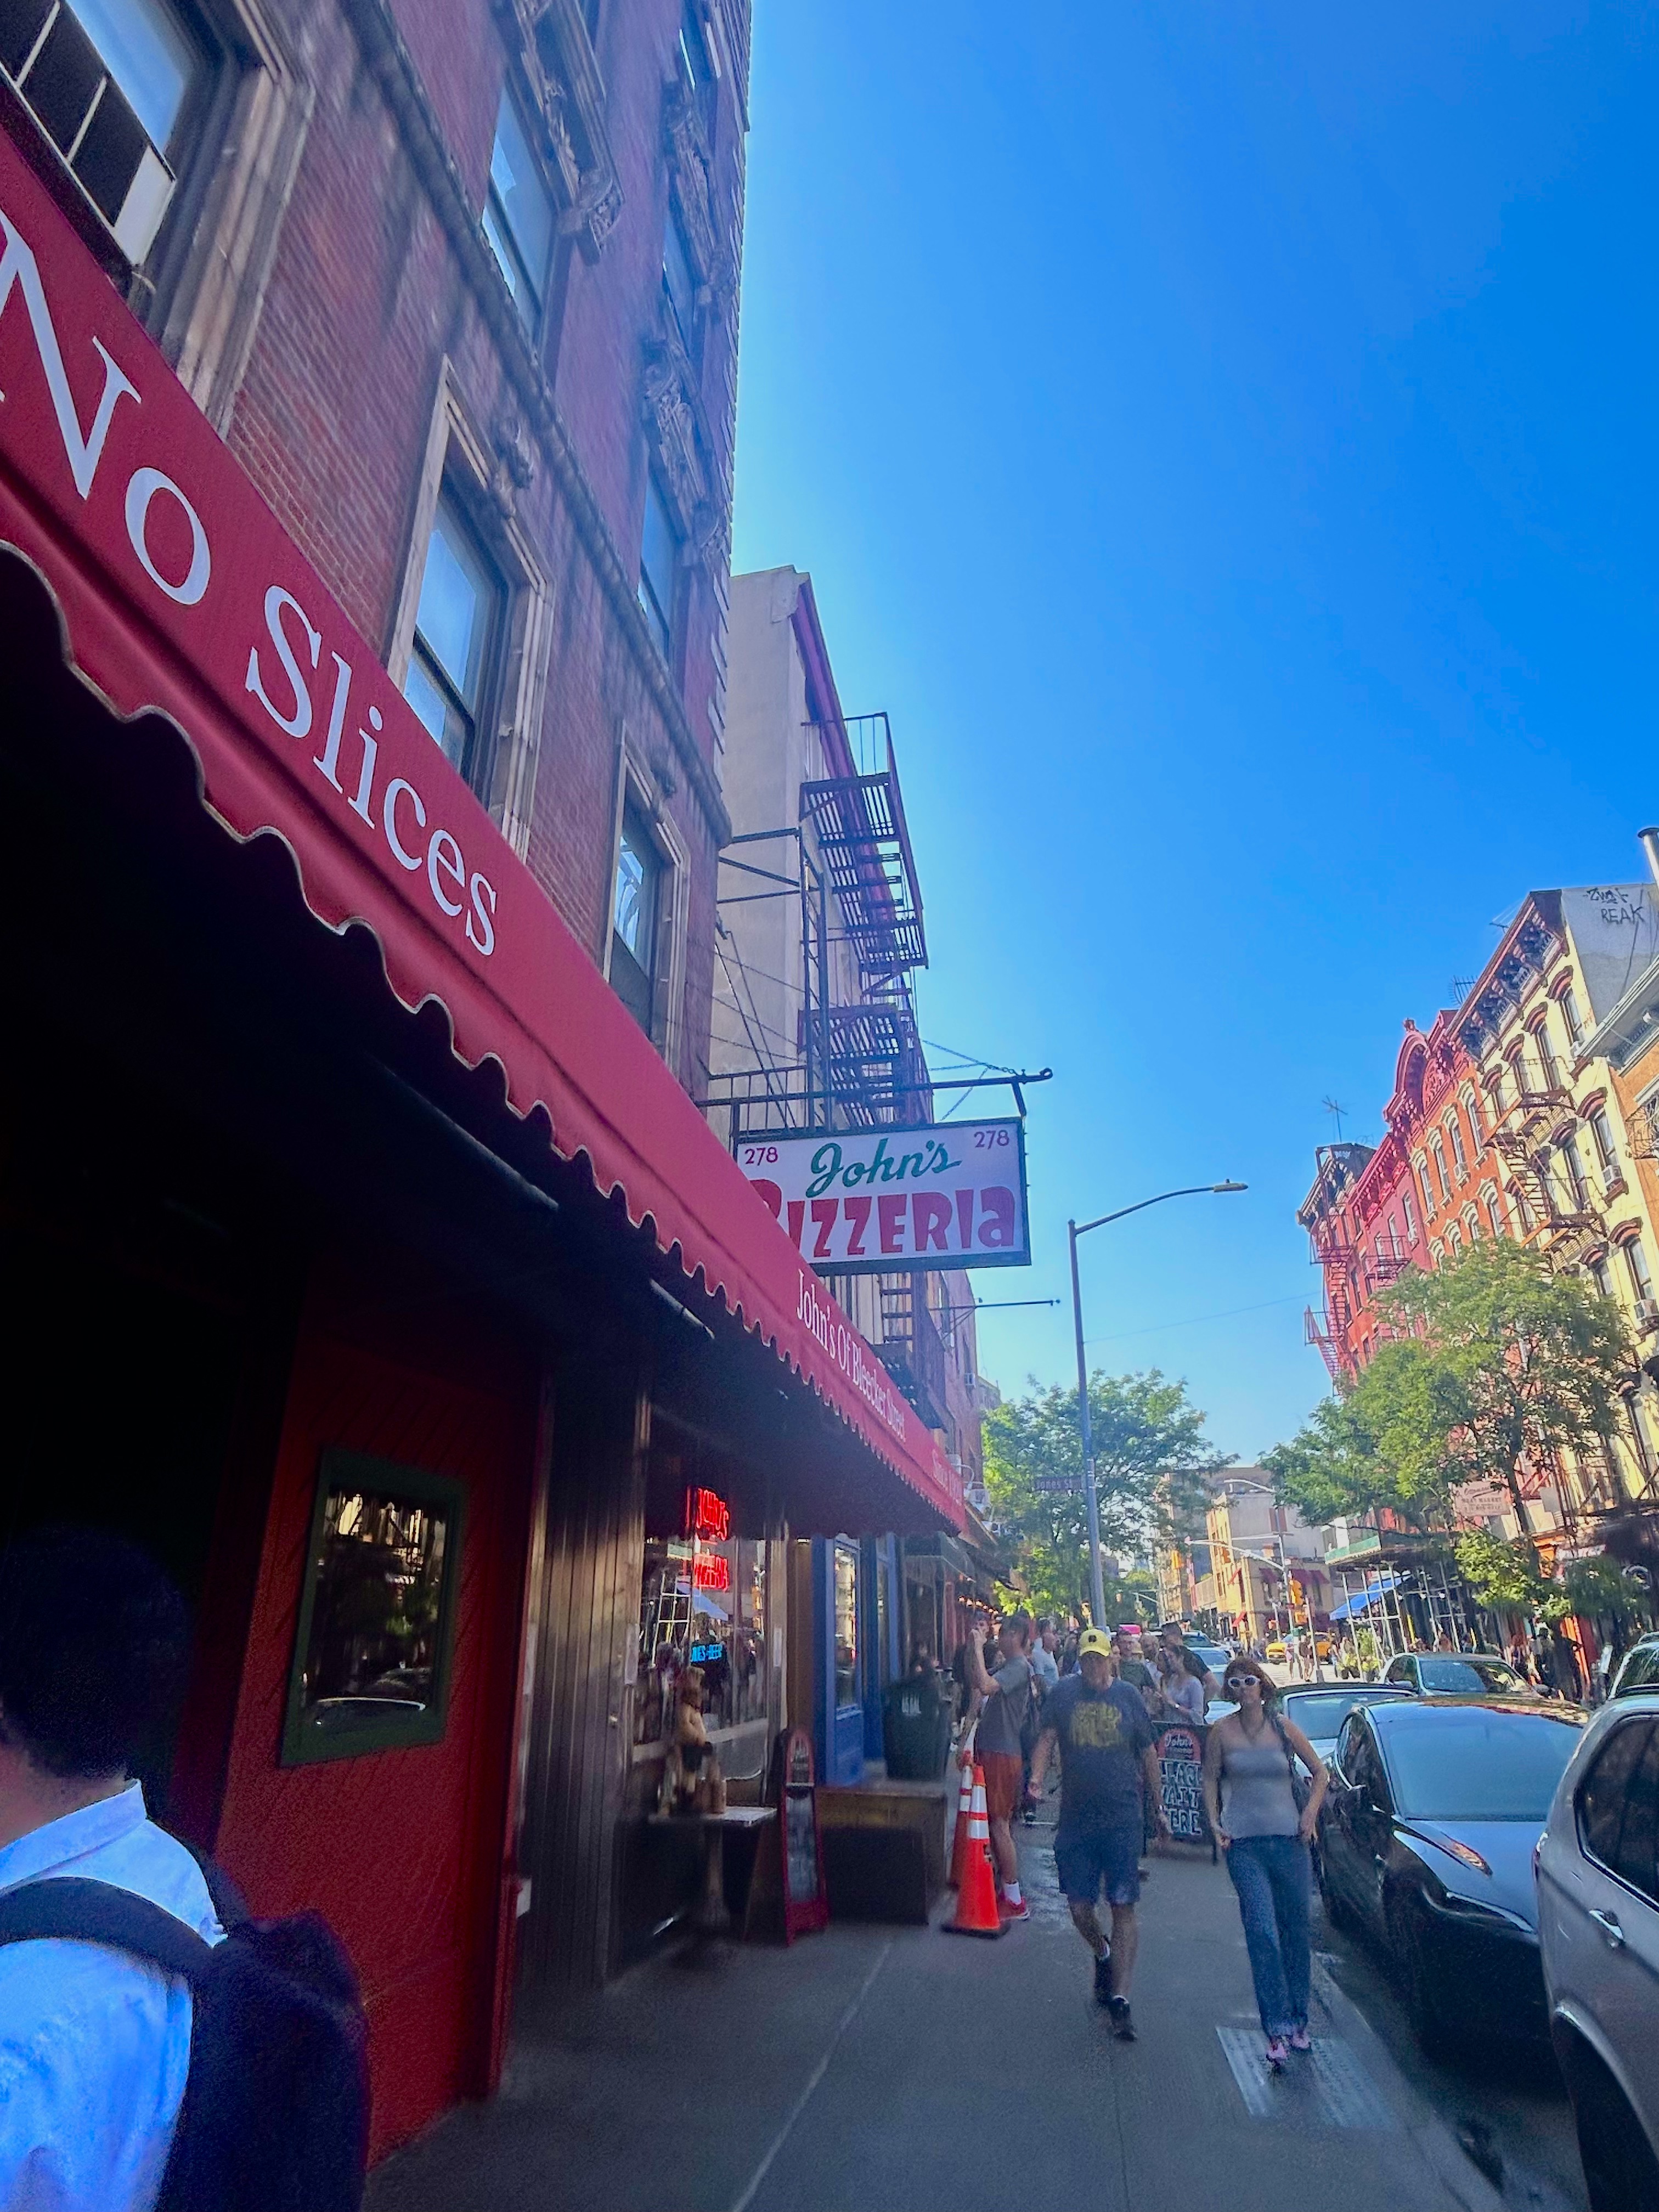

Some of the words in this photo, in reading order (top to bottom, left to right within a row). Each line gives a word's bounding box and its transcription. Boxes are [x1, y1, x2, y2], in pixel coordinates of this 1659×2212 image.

[0, 212, 212, 606] No
[244, 585, 498, 956] Slices
[744, 1146, 778, 1165] 278
[973, 1130, 1009, 1149] 278
[805, 1138, 962, 1198] John's
[797, 1268, 836, 1359] John's
[1169, 1808, 1203, 1836] ERE
